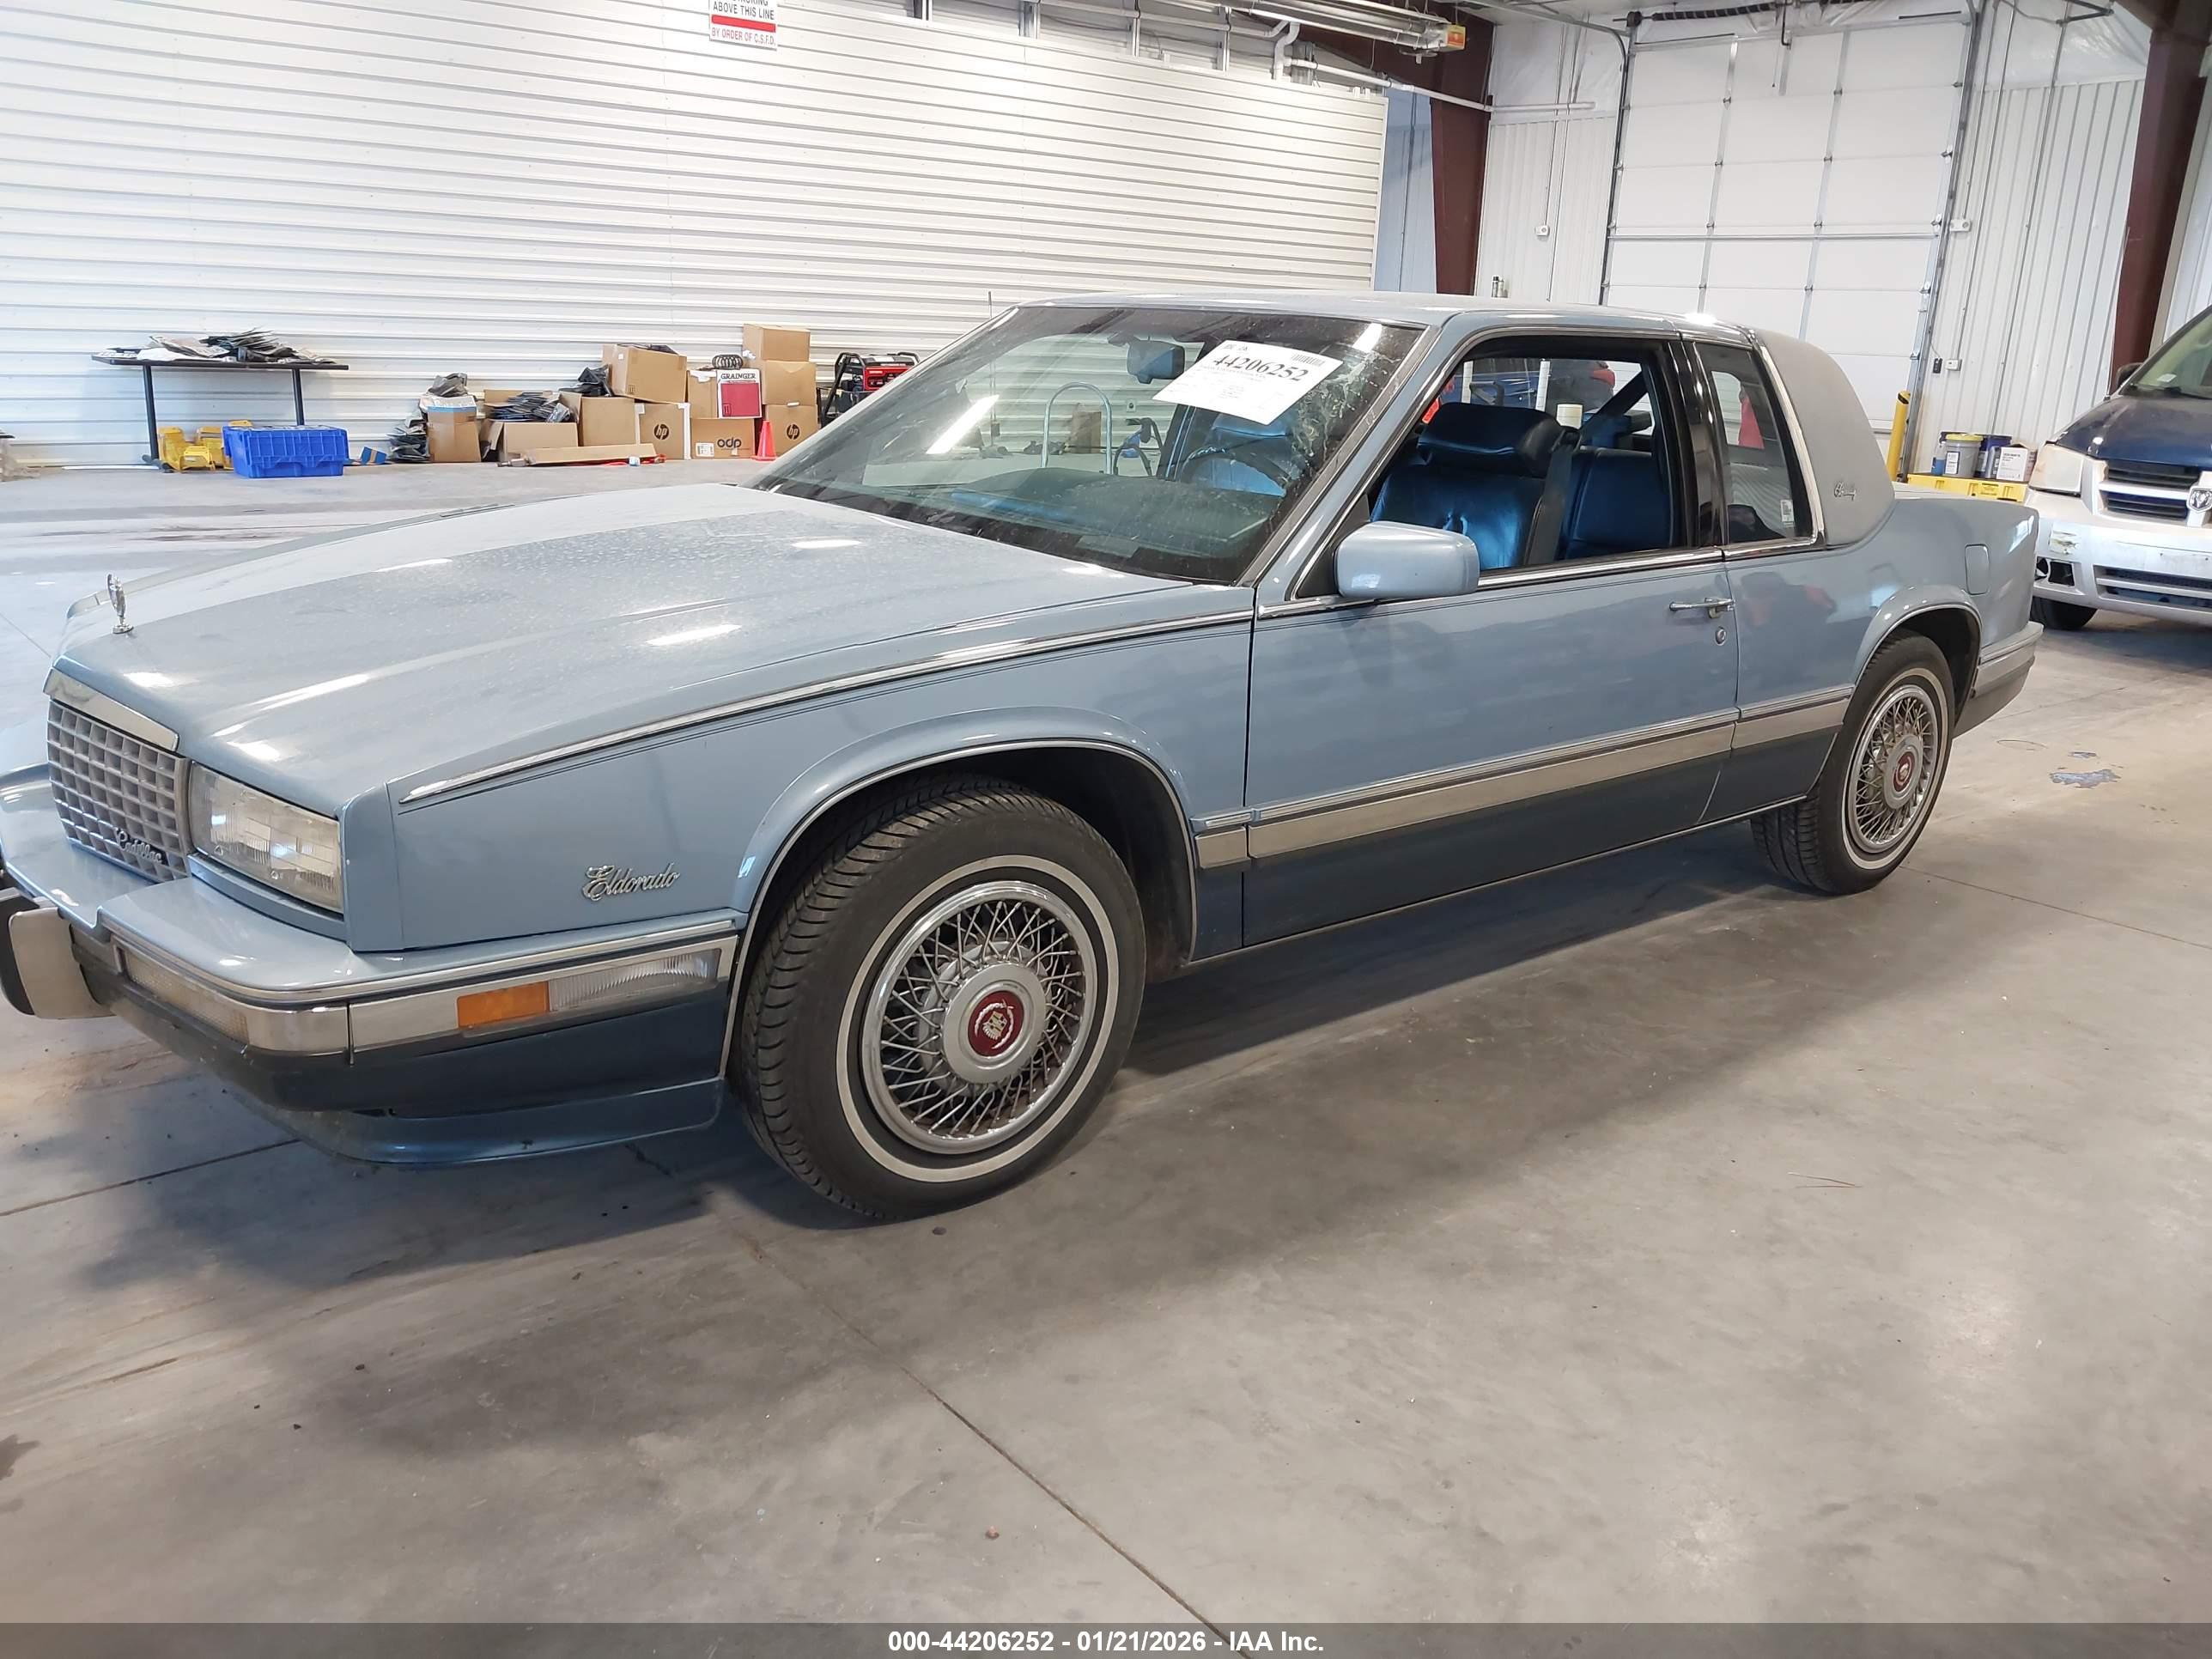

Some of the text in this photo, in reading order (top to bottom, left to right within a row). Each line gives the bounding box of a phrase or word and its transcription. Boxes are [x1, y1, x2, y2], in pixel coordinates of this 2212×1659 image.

[713, 1, 775, 20] ABOVE THIS LINE
[712, 27, 720, 37] BY
[722, 28, 743, 40] ORDER
[744, 32, 752, 41] OF
[1213, 354, 1309, 381] 44206252
[653, 423, 670, 440] hp
[787, 423, 800, 440] hp
[717, 437, 742, 448] odp
[113, 827, 163, 863] Cadillac
[582, 862, 680, 901] Eldorado
